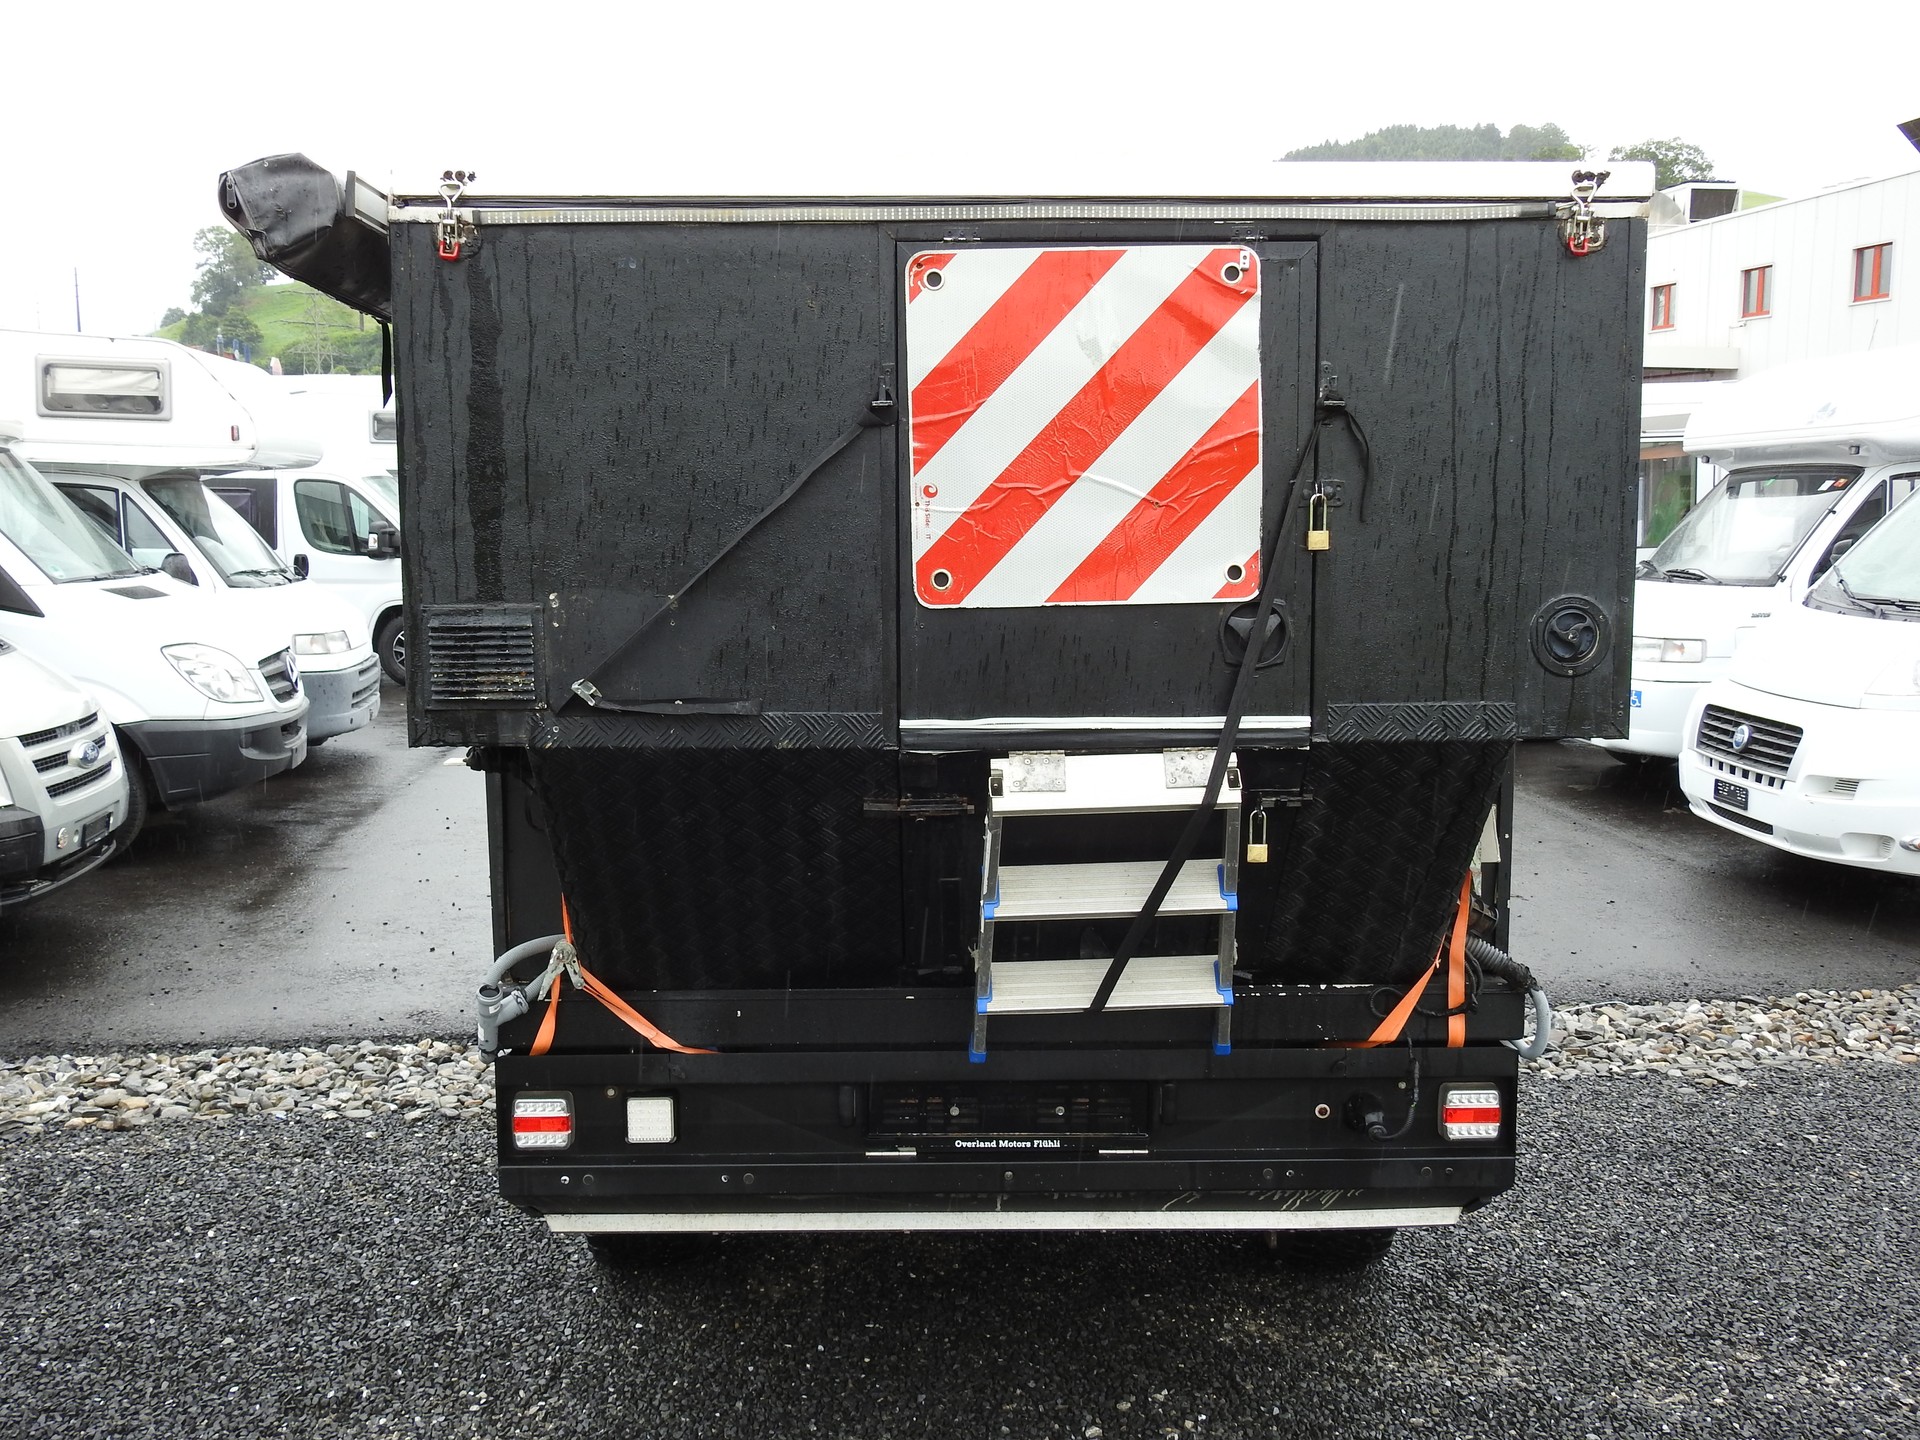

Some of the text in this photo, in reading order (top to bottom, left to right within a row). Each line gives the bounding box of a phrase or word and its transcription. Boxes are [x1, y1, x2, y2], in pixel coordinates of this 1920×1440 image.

[954, 1139, 1061, 1148] Overland Motors Flühli
